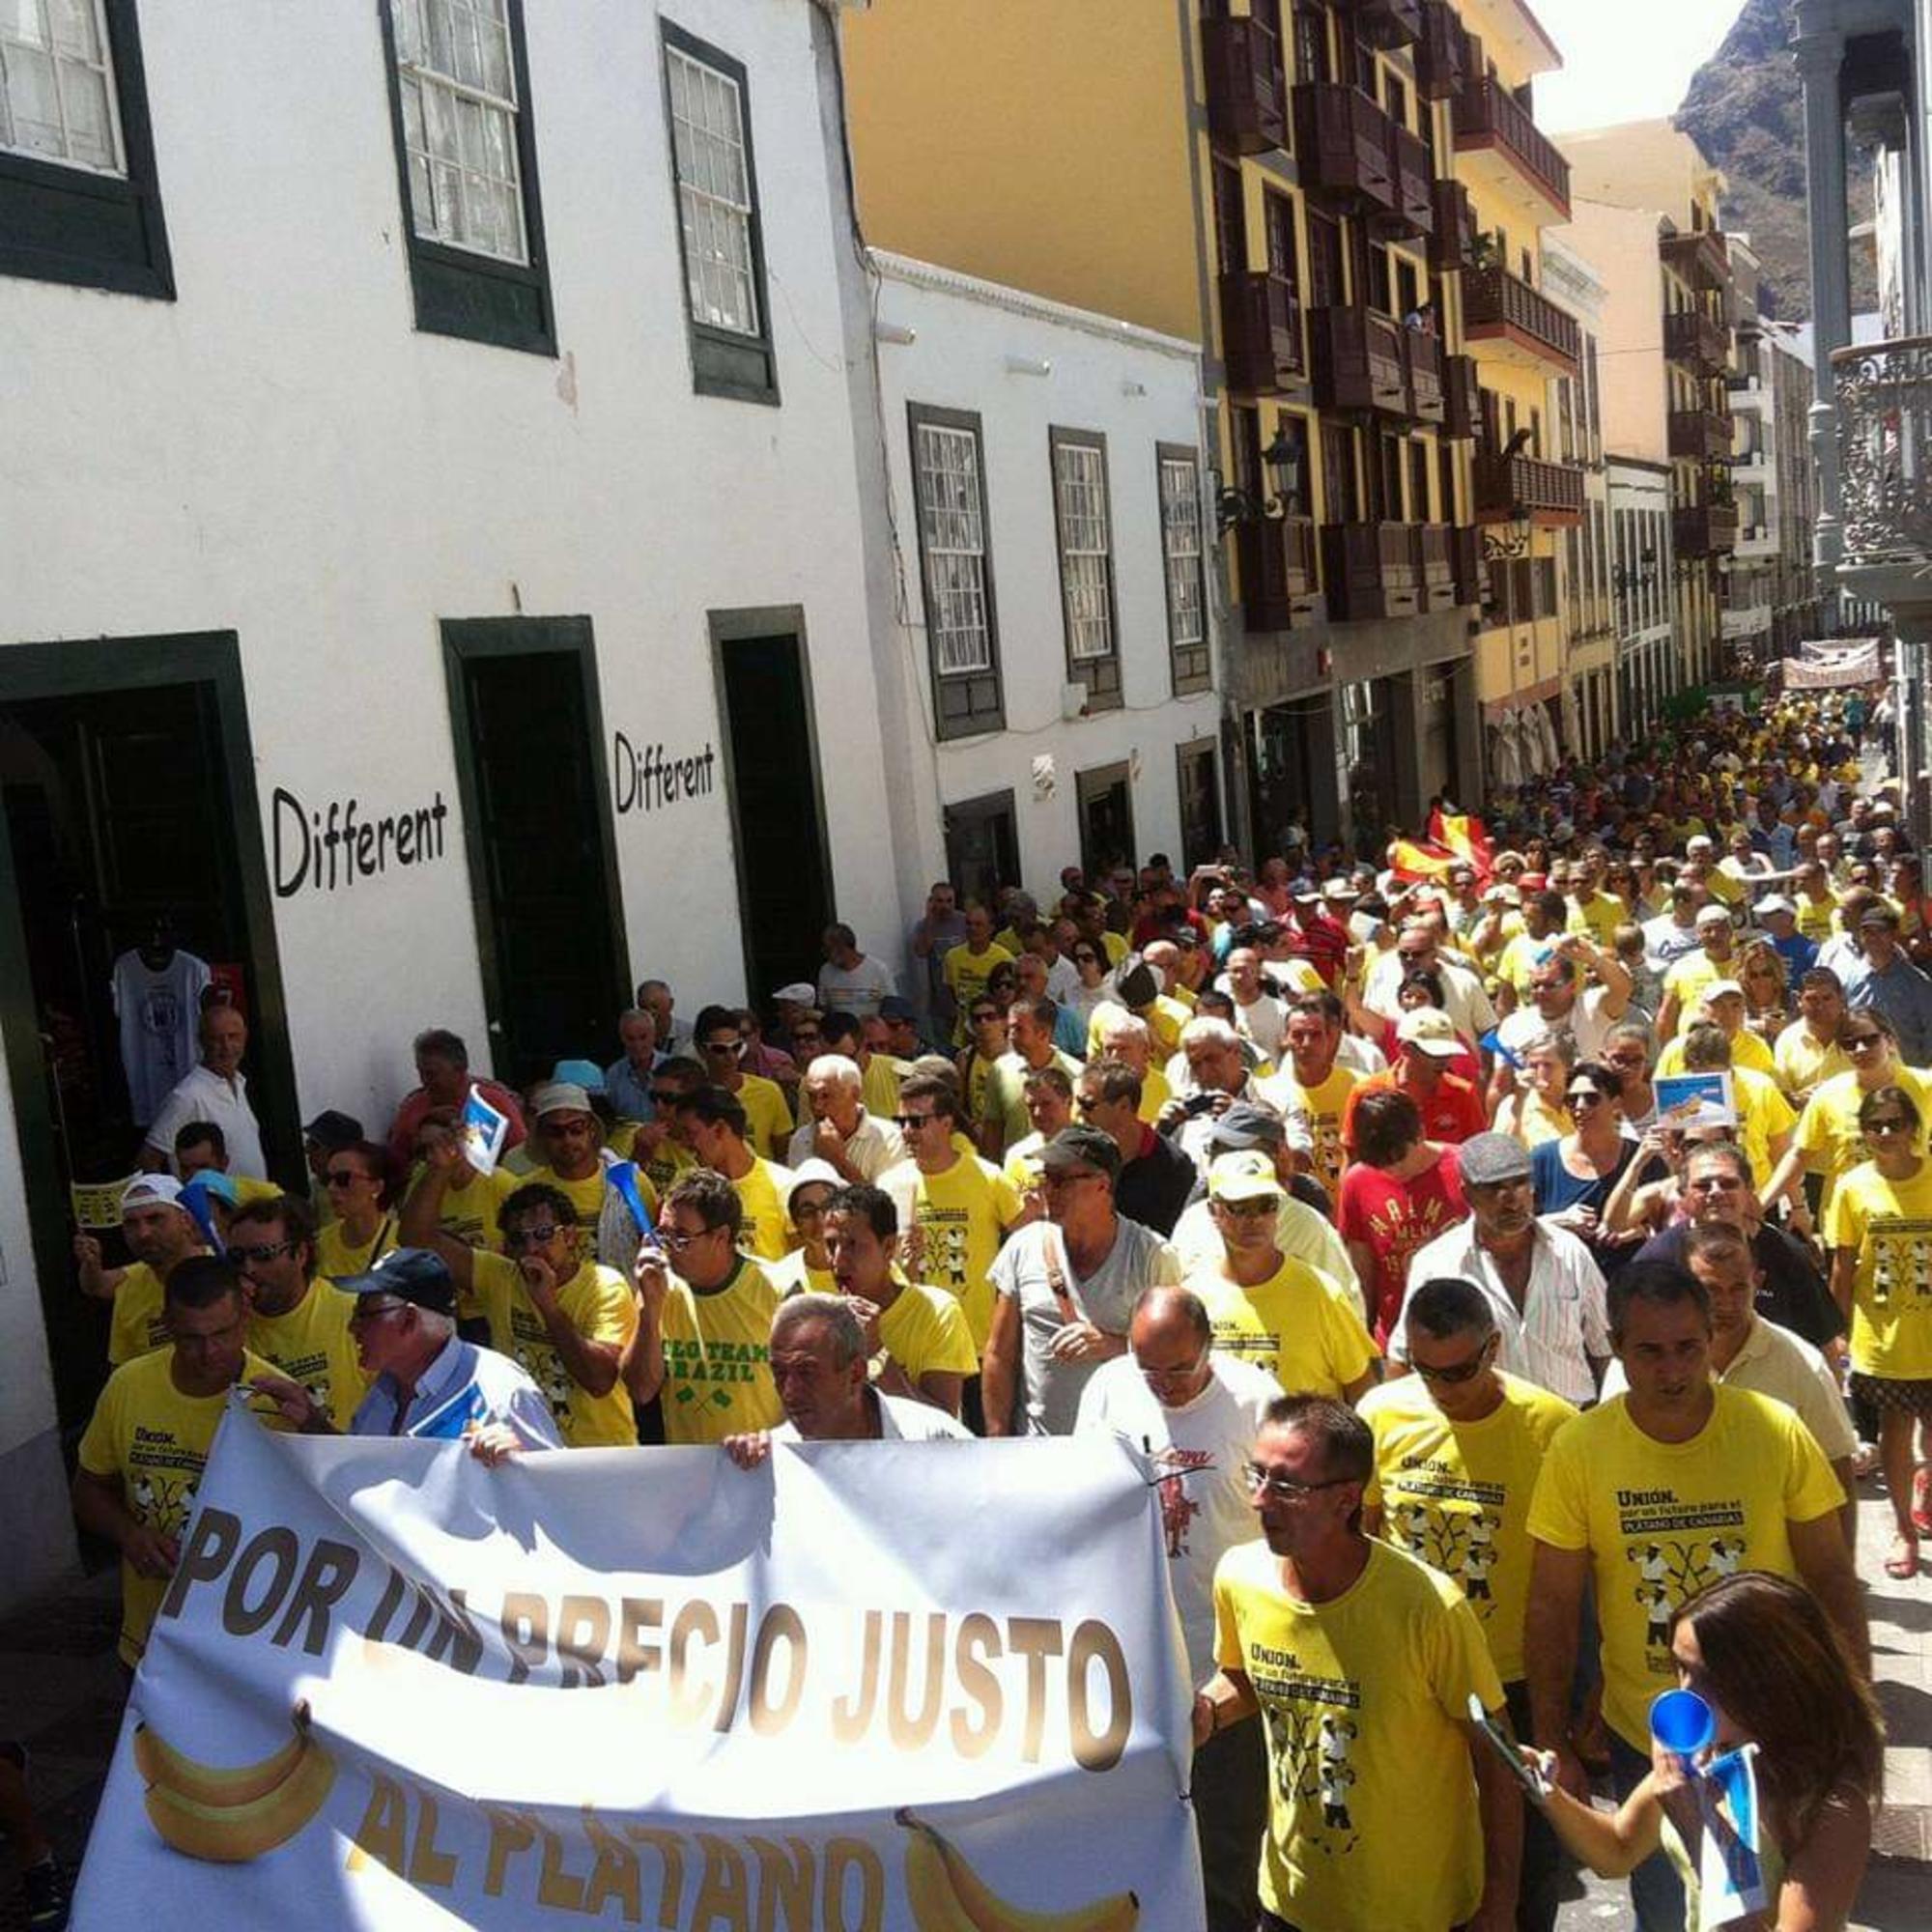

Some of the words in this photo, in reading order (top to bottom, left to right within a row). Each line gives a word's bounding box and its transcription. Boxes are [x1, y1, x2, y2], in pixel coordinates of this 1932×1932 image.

[615, 730, 715, 814] Different
[271, 785, 447, 898] Different
[160, 1507, 360, 1657] POR
[500, 1590, 808, 1738] PRECIO
[831, 1608, 1133, 1774] JUSTO
[344, 1769, 459, 1888] AL
